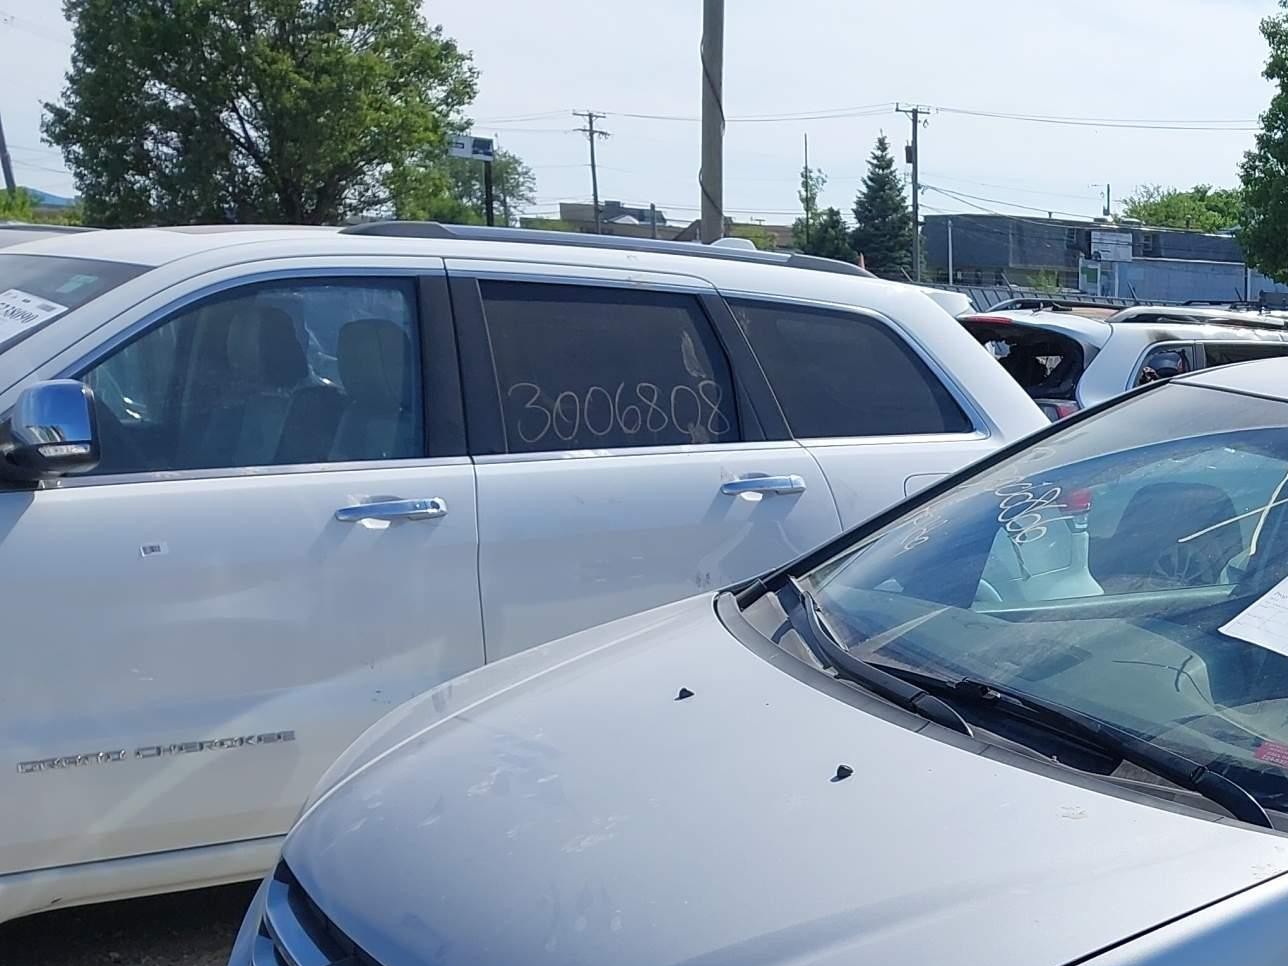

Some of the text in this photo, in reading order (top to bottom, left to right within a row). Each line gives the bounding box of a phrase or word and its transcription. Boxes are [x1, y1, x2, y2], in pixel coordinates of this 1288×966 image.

[507, 378, 731, 443] 3006808
[16, 729, 296, 774] GRAND CHEROKEE
